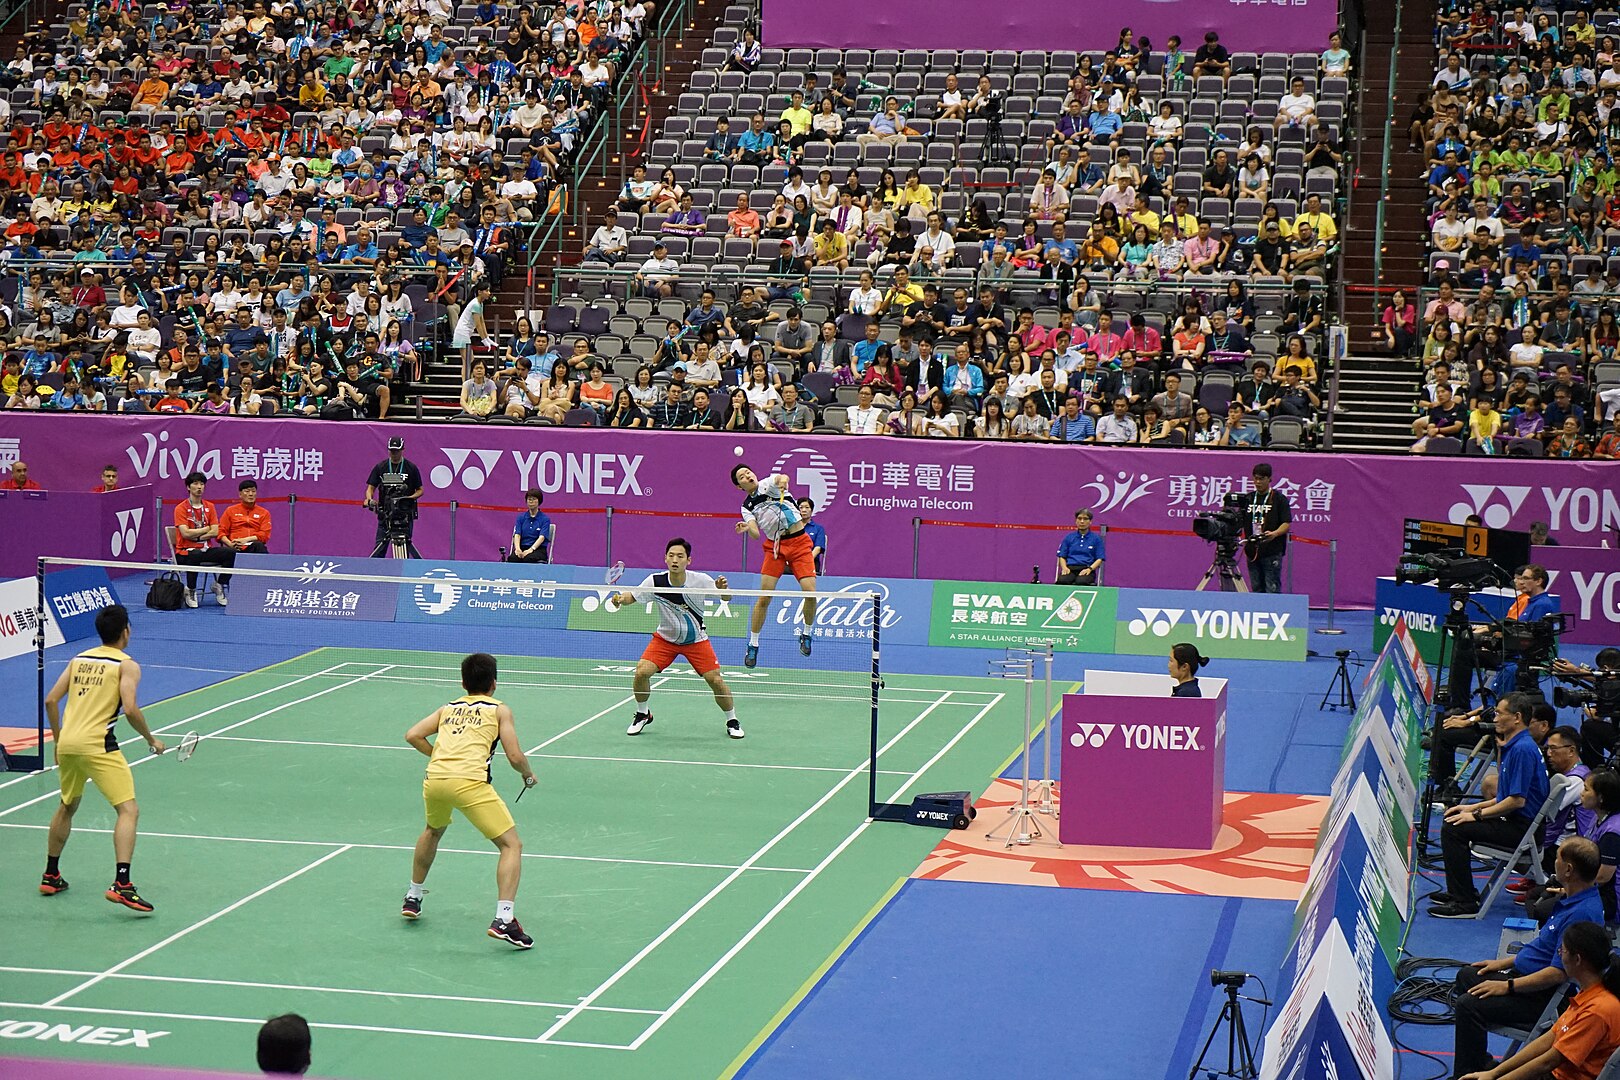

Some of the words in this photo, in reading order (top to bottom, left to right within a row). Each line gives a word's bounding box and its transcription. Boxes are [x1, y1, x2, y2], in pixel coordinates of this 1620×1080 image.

[231, 447, 324, 481] 萬歲牌
[512, 451, 643, 496] YONEX
[849, 461, 975, 491] 中華電信
[848, 494, 918, 511] Chunghwa
[921, 497, 973, 510] Telecom
[1473, 533, 1481, 551] 9
[263, 588, 361, 610] 勇源基金會
[467, 599, 515, 611] Chunghwa
[516, 600, 554, 611] Telecom
[308, 609, 355, 617] FOUNDATION
[951, 609, 1028, 626] 長榮航空
[1402, 610, 1437, 633] YONEX
[1191, 610, 1290, 641] YONEX
[981, 635, 1023, 643] ALLIANCE
[475, 707, 482, 716] K
[1121, 724, 1200, 751] YONEX
[928, 811, 949, 821] YONEX
